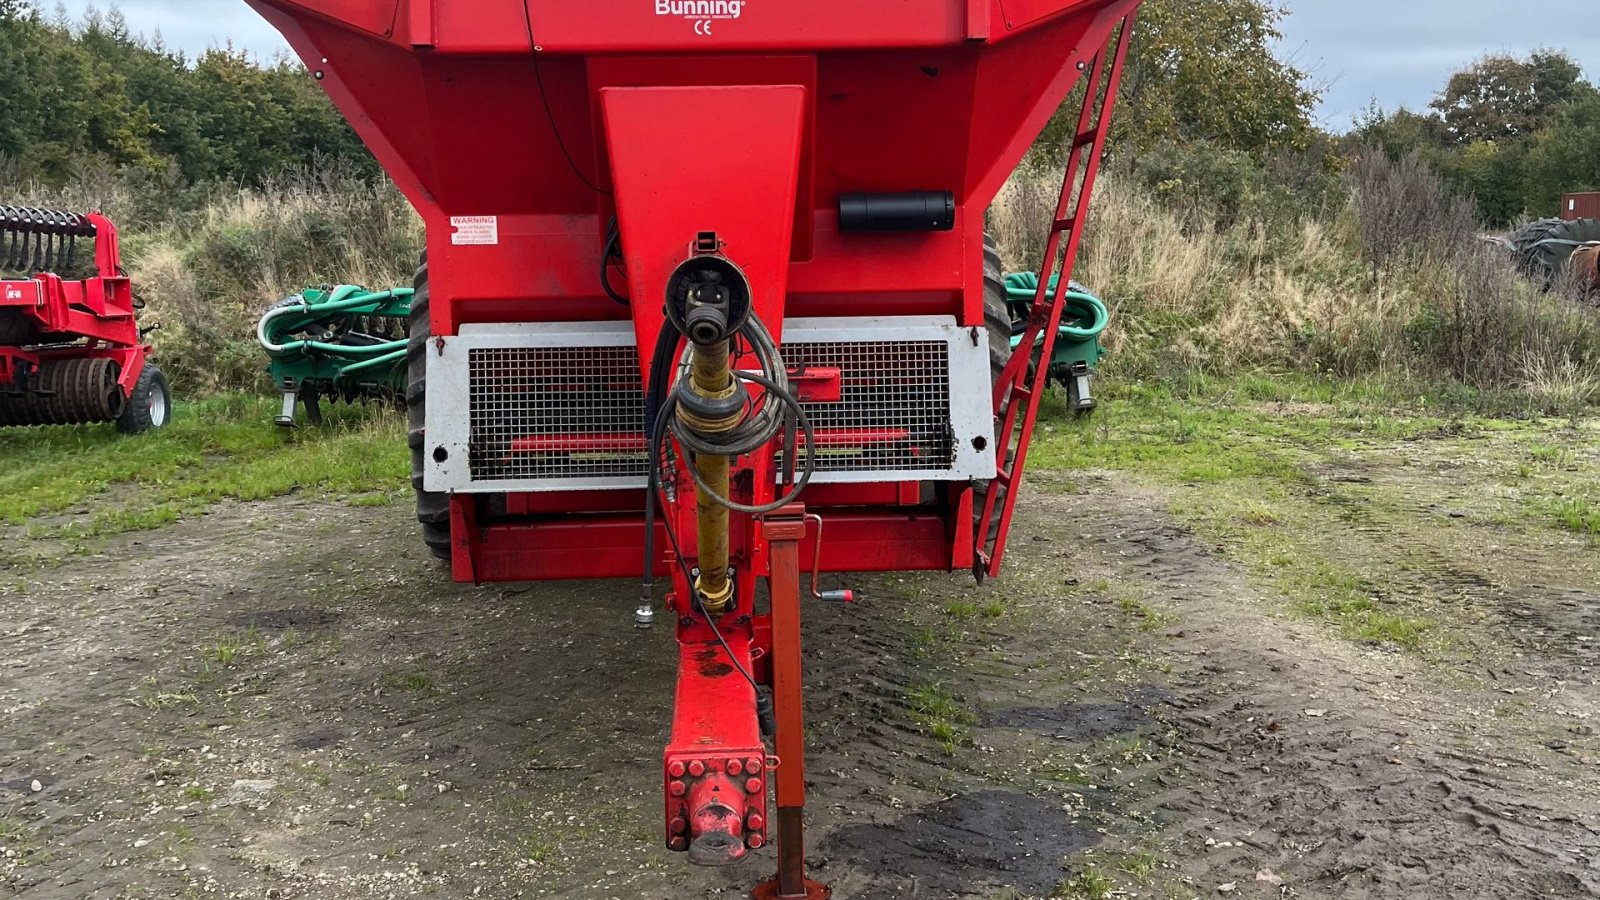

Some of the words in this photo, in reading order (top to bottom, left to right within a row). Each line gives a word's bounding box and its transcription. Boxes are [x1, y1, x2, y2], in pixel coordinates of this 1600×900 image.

[655, 0, 741, 18] Bunning
[694, 20, 712, 35] CE
[453, 216, 494, 224] WARNING
